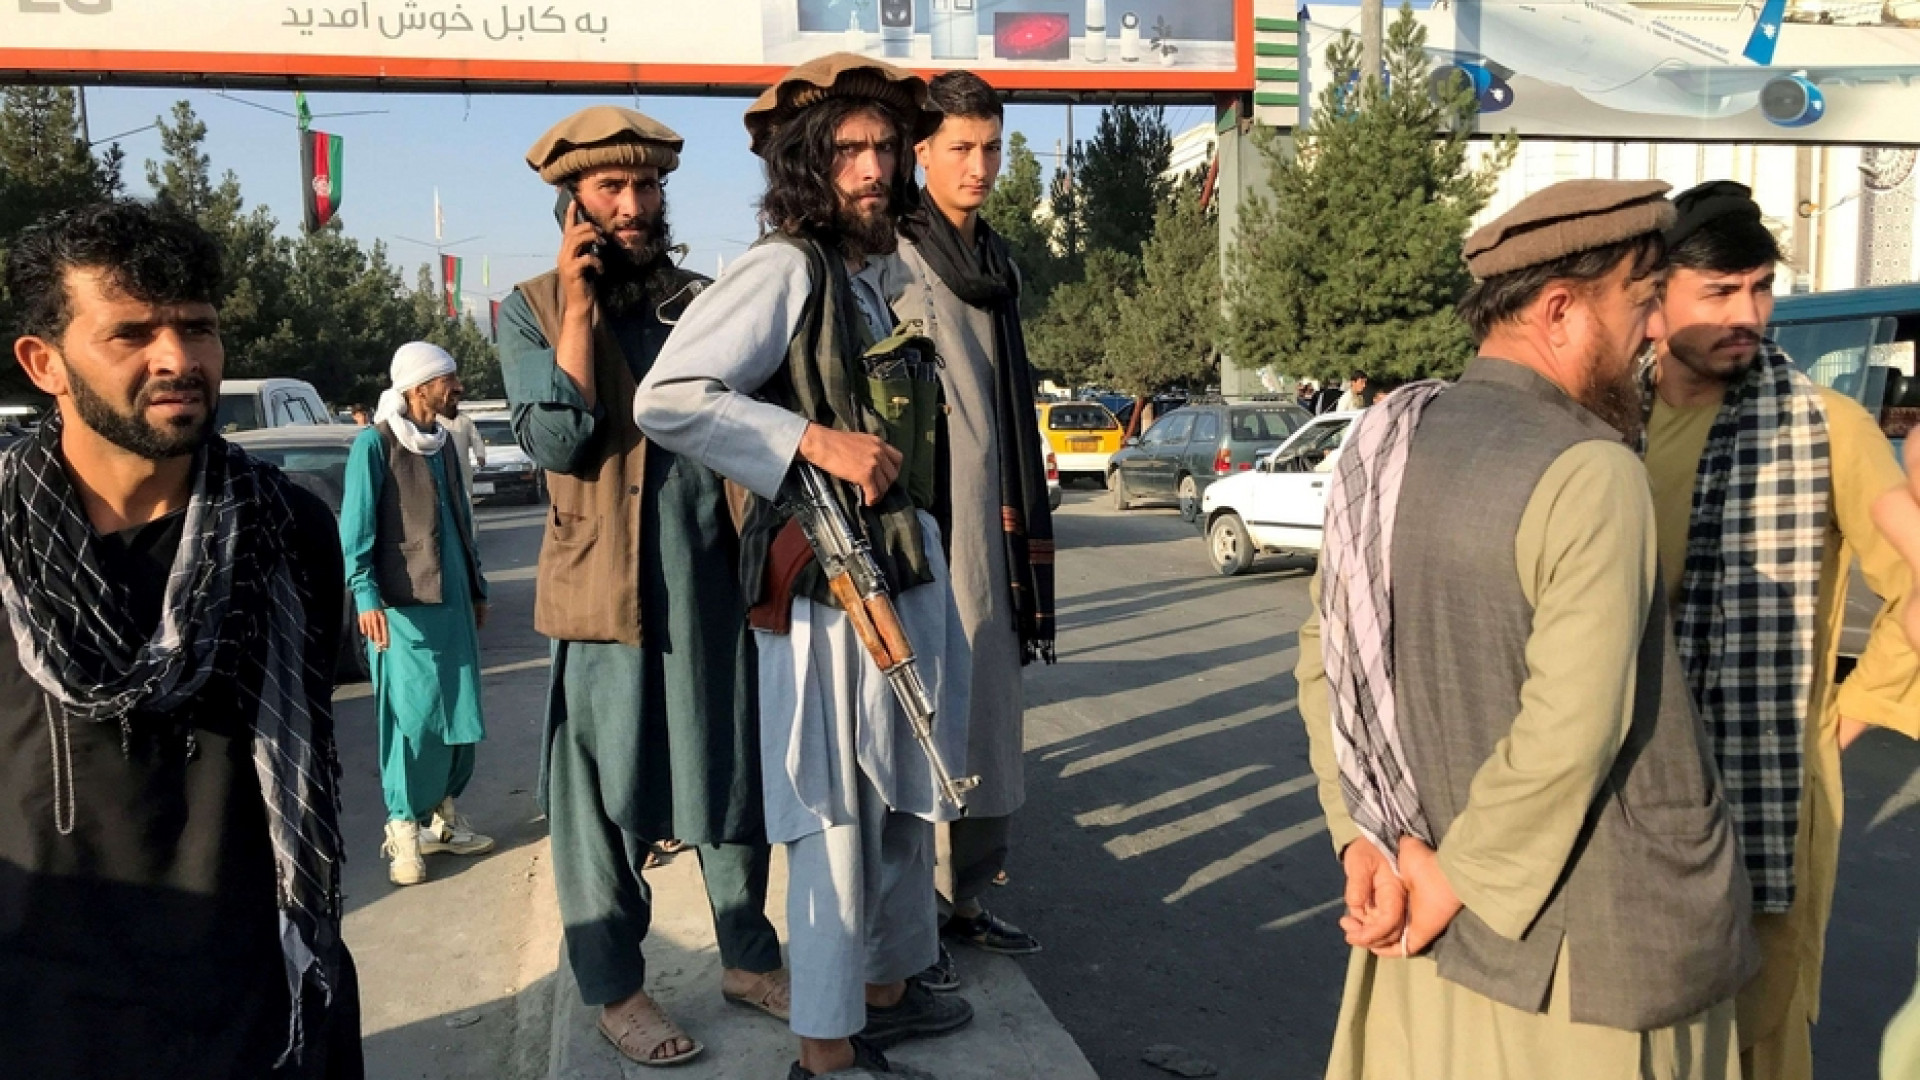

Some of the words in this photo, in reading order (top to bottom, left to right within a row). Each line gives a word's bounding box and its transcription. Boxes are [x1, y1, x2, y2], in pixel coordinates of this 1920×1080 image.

[378, 0, 474, 39] خوش
[483, 5, 567, 41] کابل
[575, 11, 608, 43] به
